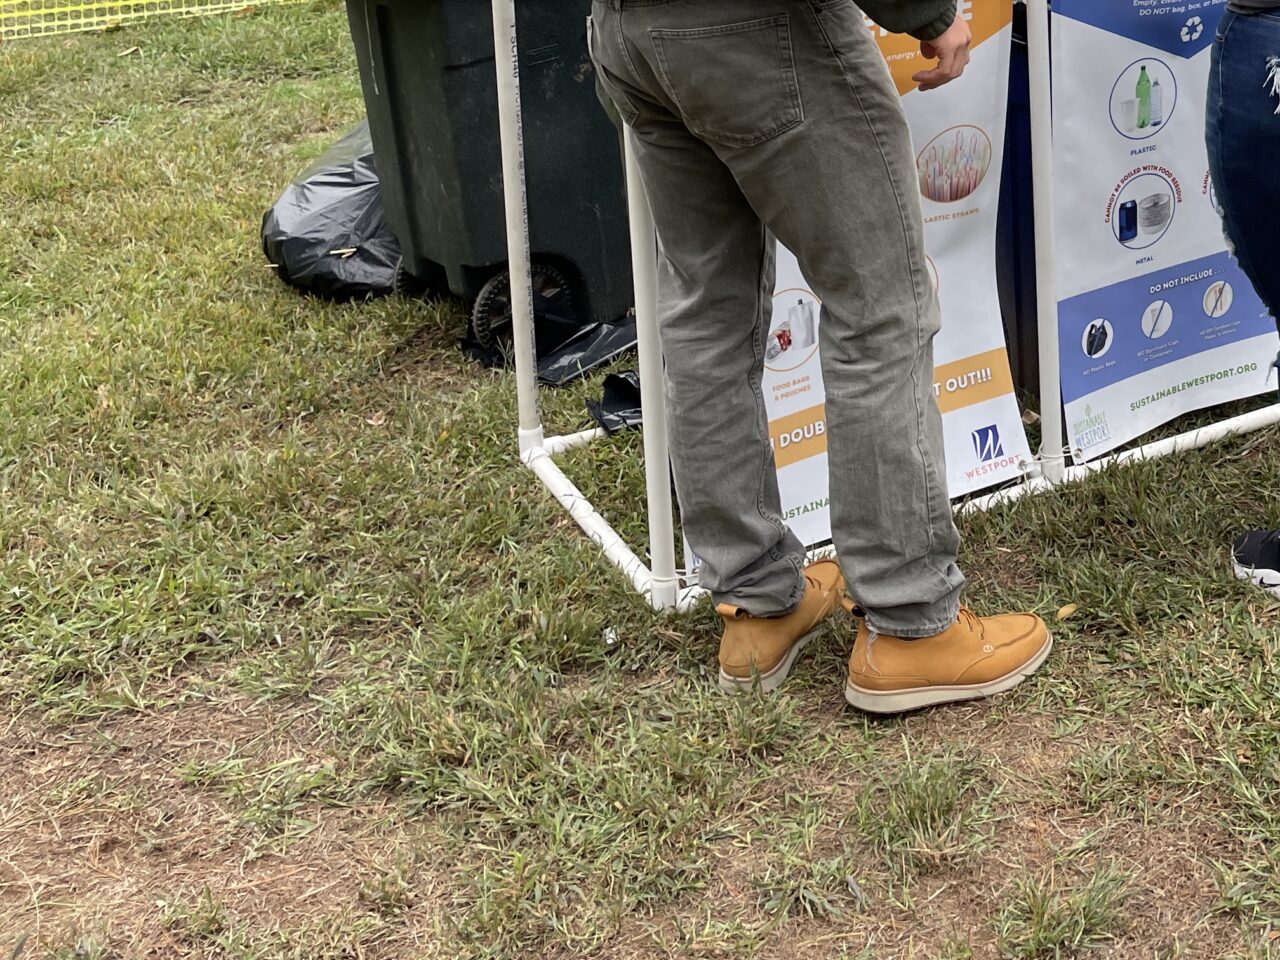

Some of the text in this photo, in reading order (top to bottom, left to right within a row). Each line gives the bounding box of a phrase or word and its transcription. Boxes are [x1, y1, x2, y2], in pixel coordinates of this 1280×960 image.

[1139, 8, 1151, 16] DO
[1153, 7, 1171, 16] NOT
[886, 50, 916, 62] energy
[1130, 144, 1157, 156] PLASTIC
[1104, 193, 1116, 224] CANNOT
[1120, 167, 1141, 184] SOILED
[1142, 164, 1158, 172] WITH
[1158, 166, 1173, 179] FOOD
[924, 207, 980, 224] LASTIC STRAWS
[1135, 255, 1155, 265] METAL
[1149, 284, 1162, 294] DO
[1163, 278, 1179, 290] NOT
[772, 374, 811, 392] FOOD BAGS
[944, 367, 993, 393] OUT!!!
[1130, 362, 1258, 412] SUSTAINABLEWESTPORT.ORG
[781, 384, 812, 400] POUCHES
[779, 419, 826, 450] DOUB
[1074, 423, 1111, 449] WESTPORT
[965, 453, 1022, 480] WESTPORT
[781, 497, 831, 522] USTAINA
